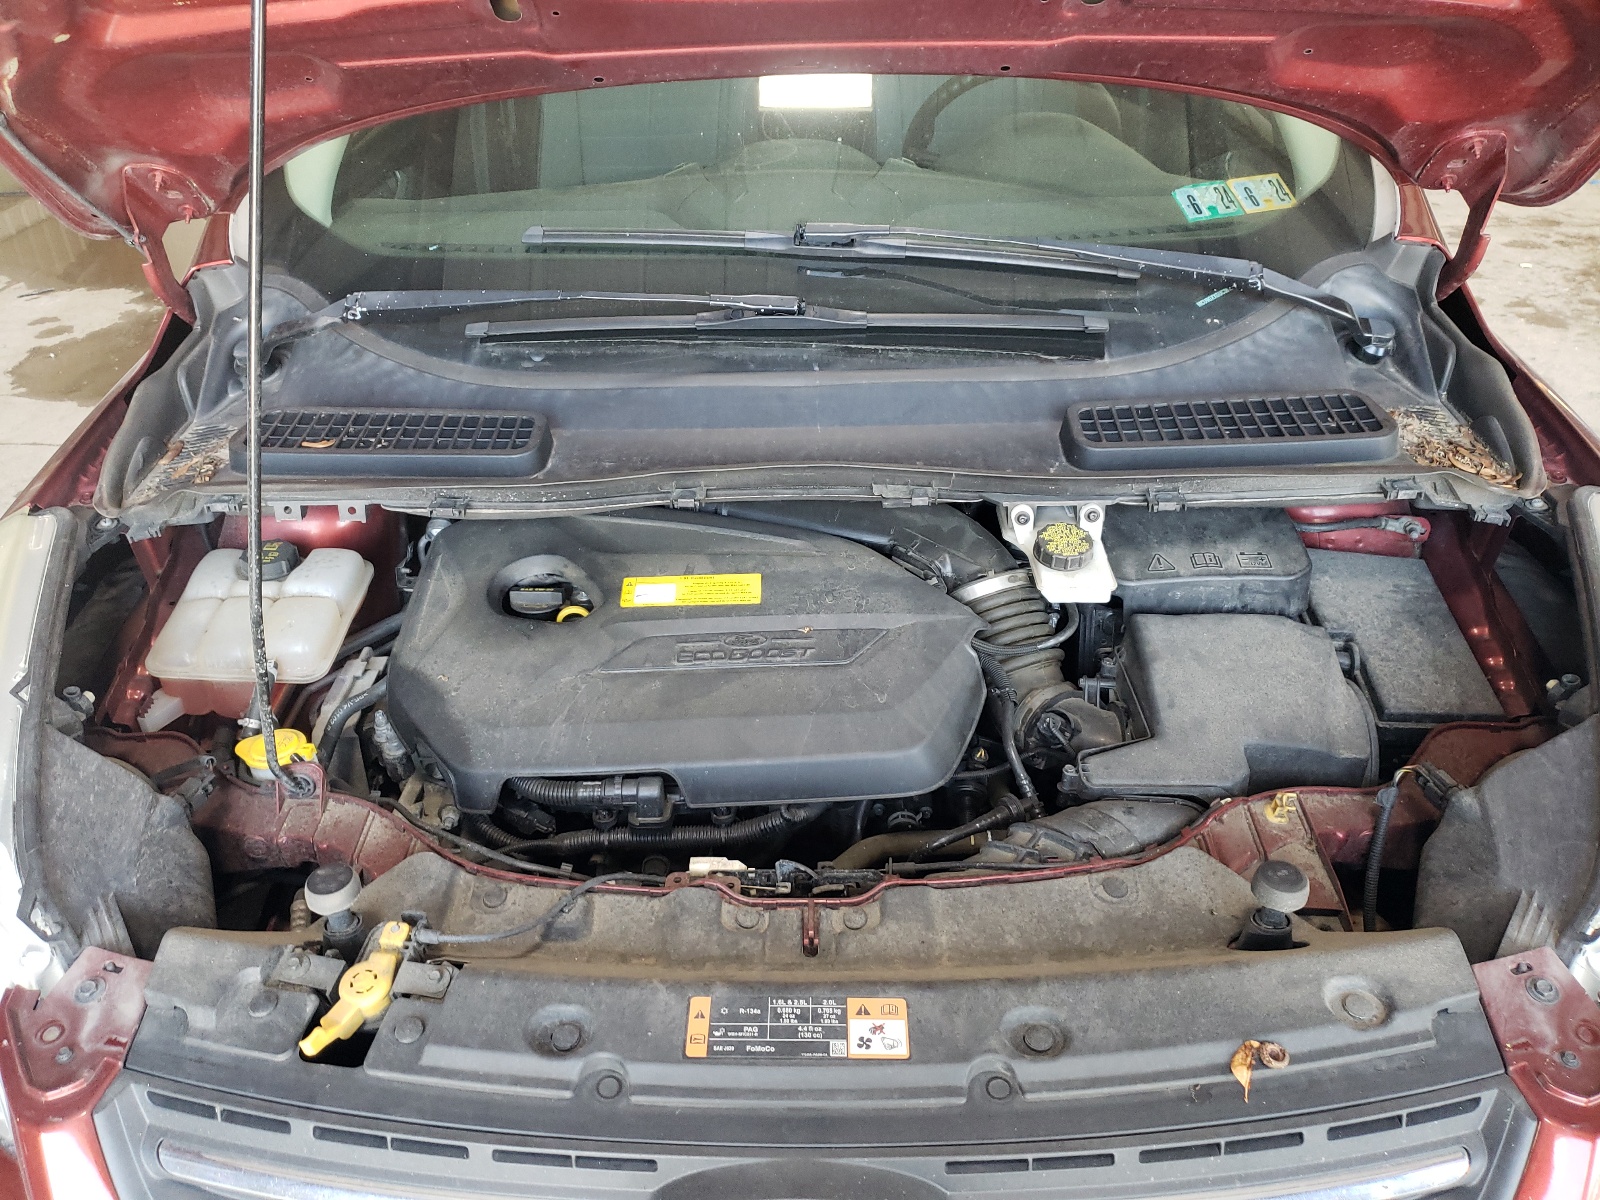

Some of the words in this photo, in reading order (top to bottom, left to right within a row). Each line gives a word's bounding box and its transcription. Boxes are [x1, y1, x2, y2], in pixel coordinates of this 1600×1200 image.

[1187, 194, 1203, 215] 6
[1213, 185, 1238, 209] 24
[1243, 186, 1260, 207] 6
[1267, 178, 1292, 202] 24
[676, 647, 816, 664] ECOBOOST
[793, 1007, 801, 1015] kg
[833, 1007, 842, 1015] kg
